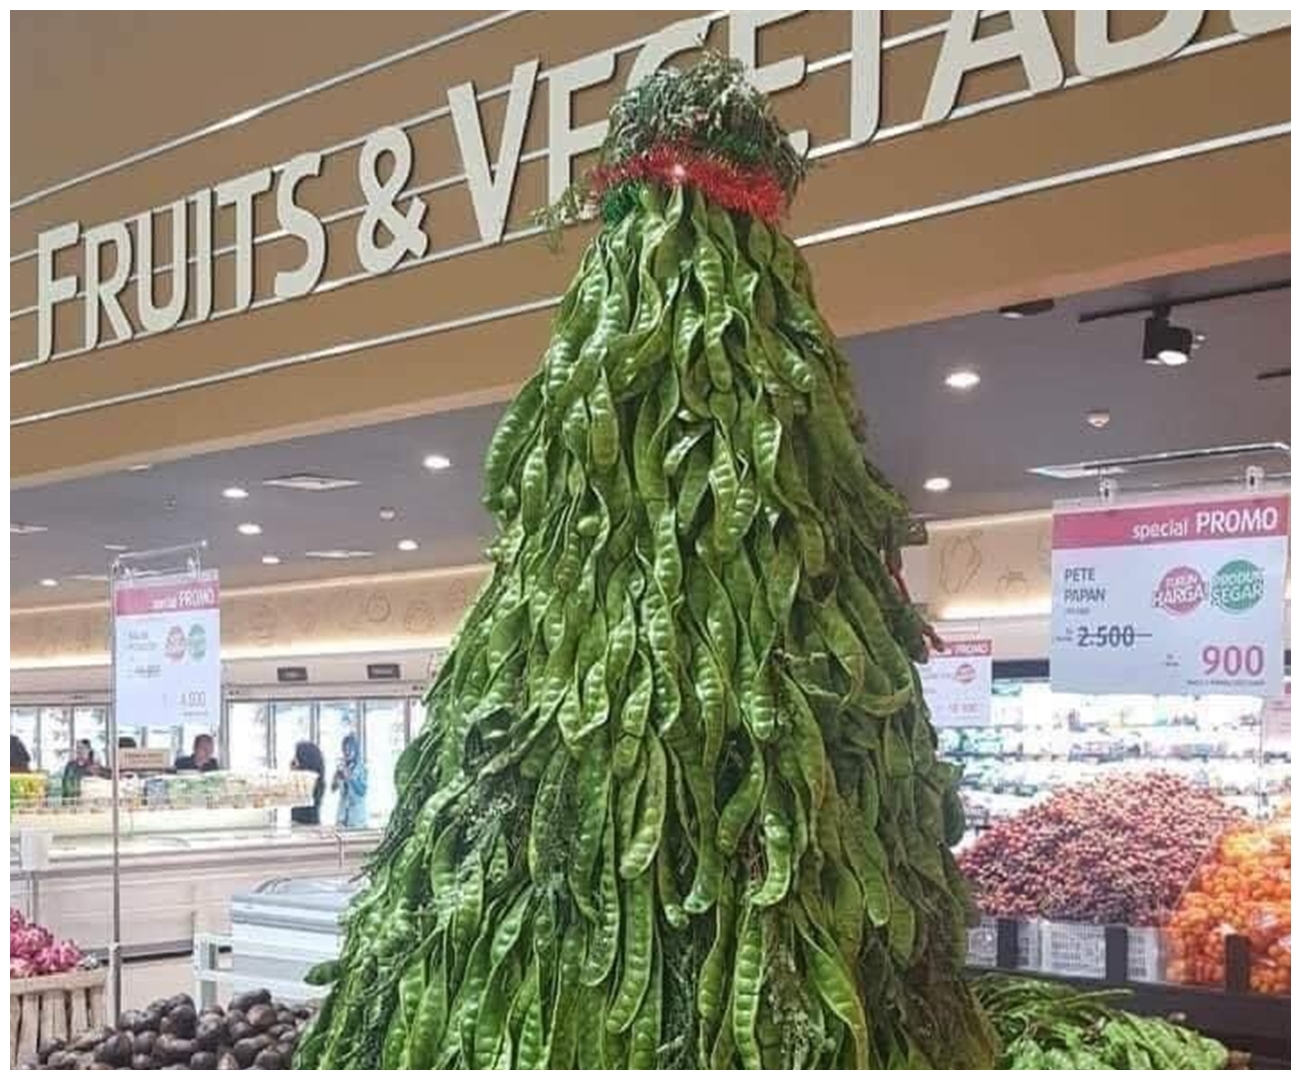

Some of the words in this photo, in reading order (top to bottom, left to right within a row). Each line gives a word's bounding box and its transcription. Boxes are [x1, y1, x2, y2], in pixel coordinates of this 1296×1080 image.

[37, 151, 326, 363] FRUITS
[356, 126, 429, 274] &
[1132, 519, 1188, 541] special
[1195, 507, 1279, 534] PROMO
[1064, 567, 1096, 581] PETE
[1064, 588, 1107, 602] PAPAN
[1211, 582, 1264, 607] SEGAR
[1077, 625, 1135, 648] 2.500
[1202, 644, 1265, 678] 900
